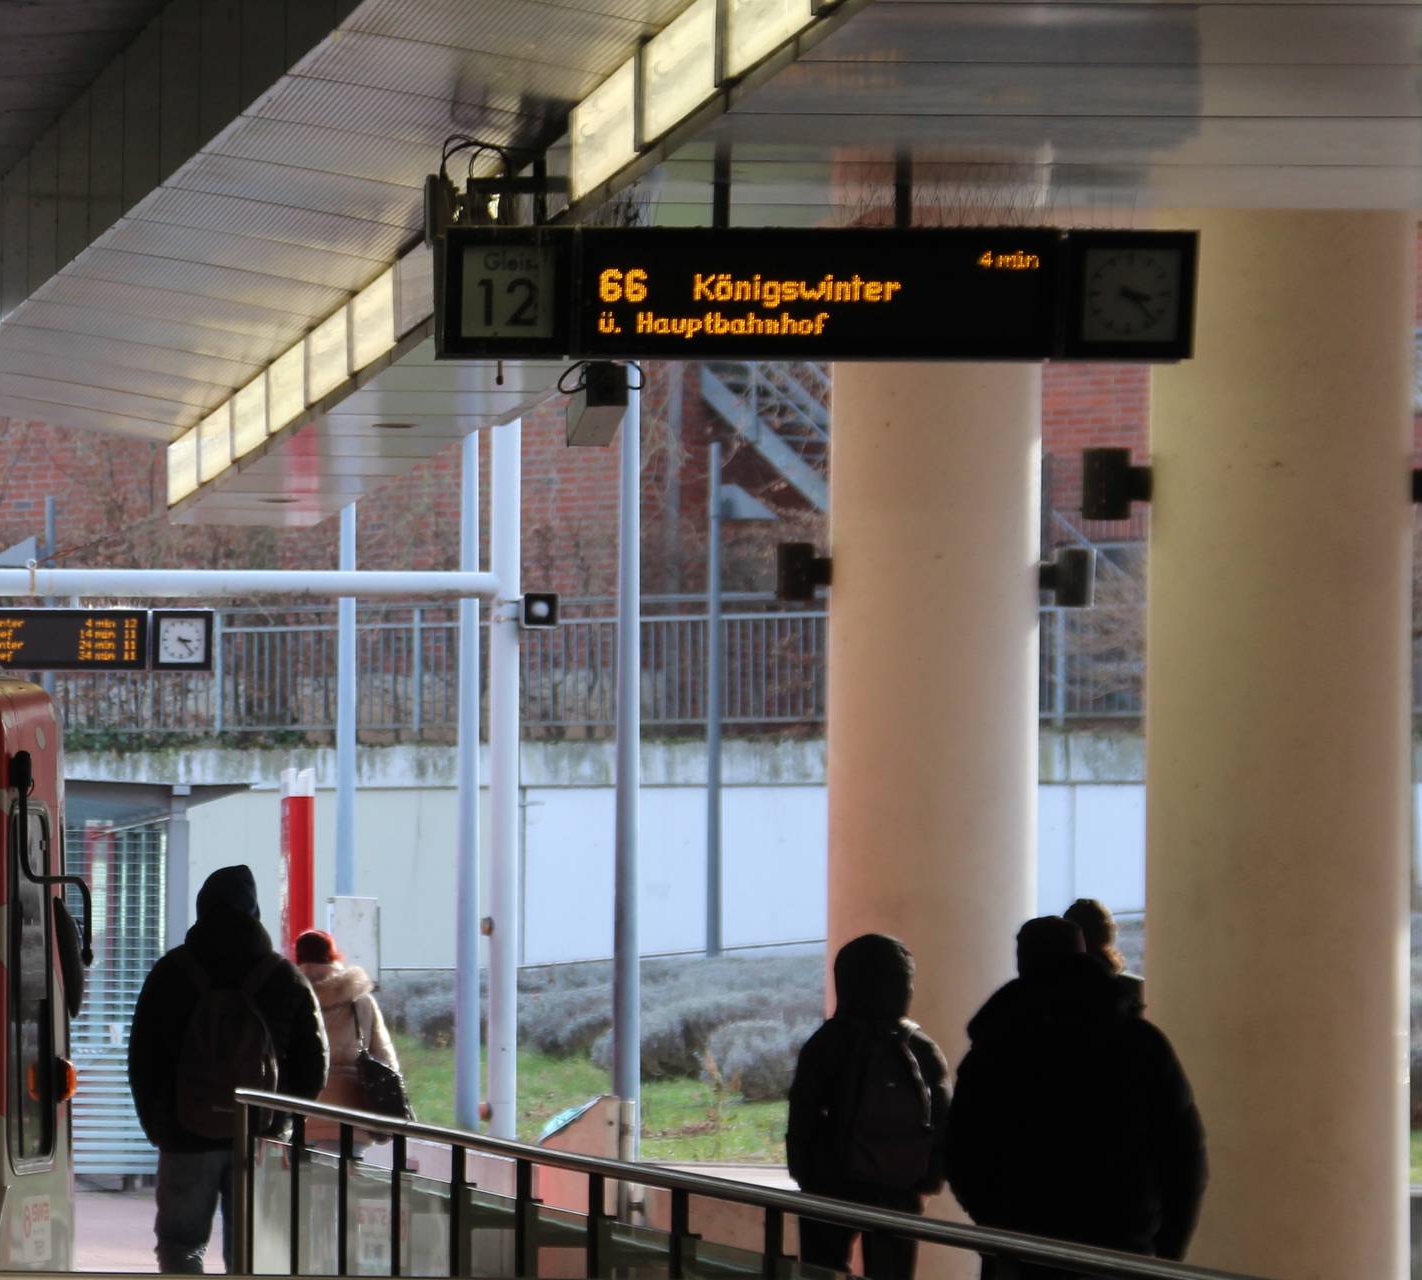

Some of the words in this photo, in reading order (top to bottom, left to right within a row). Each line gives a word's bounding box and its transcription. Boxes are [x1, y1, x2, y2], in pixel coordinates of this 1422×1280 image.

[979, 250, 993, 268] 4
[996, 250, 1040, 270] min
[598, 268, 648, 304] 66
[693, 273, 902, 309] Königswinter
[477, 277, 538, 327] 12
[598, 311, 622, 335] ü.
[636, 310, 830, 340] Hauptbahnhof
[85, 618, 93, 628] 4
[95, 618, 116, 629] min
[124, 618, 138, 628] 12
[95, 629, 116, 640] min
[95, 640, 116, 650] min
[95, 651, 116, 661] min
